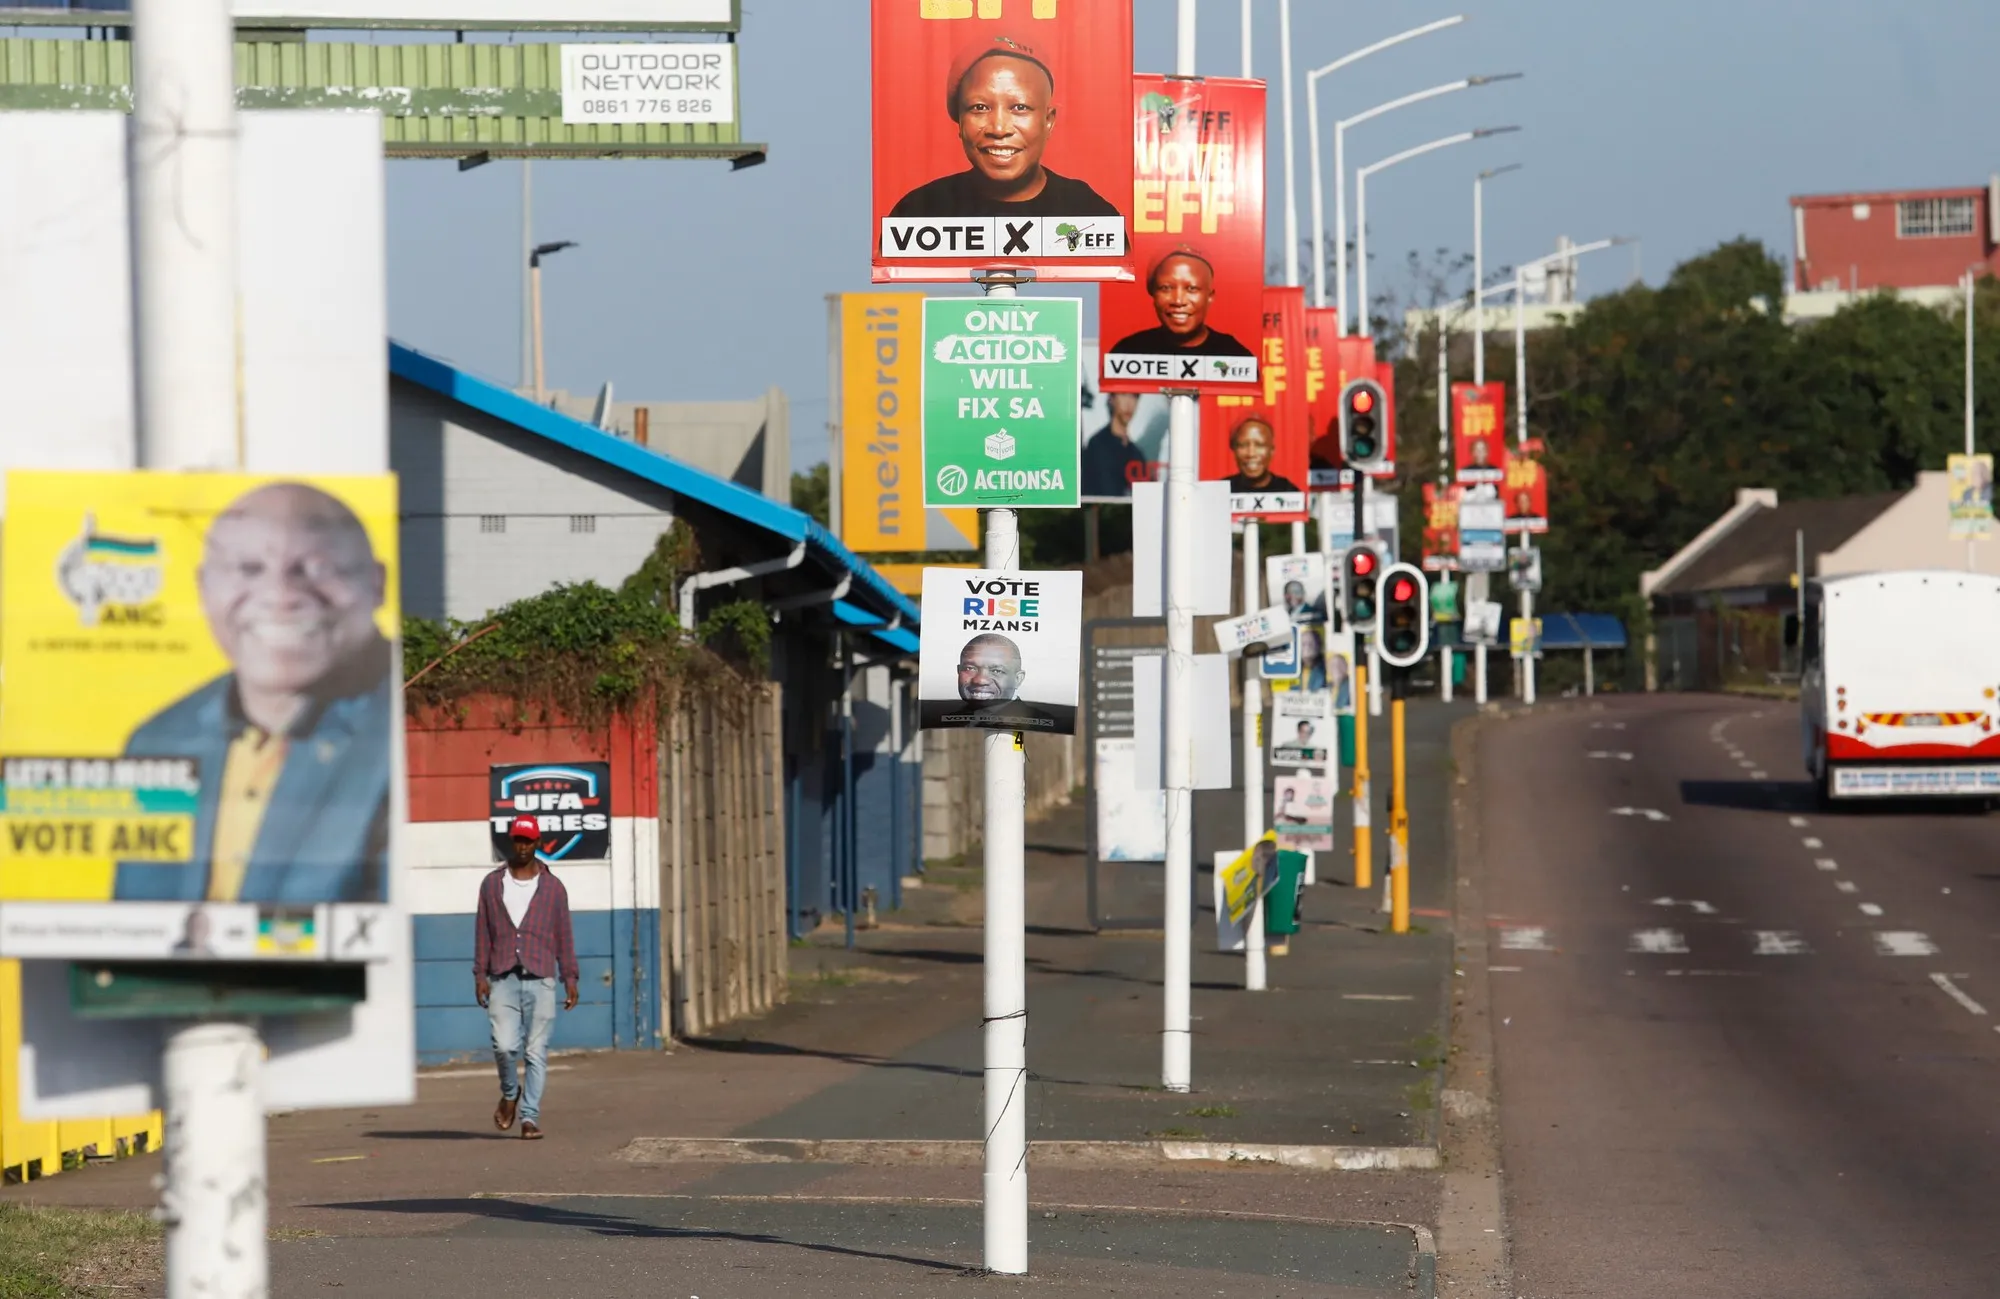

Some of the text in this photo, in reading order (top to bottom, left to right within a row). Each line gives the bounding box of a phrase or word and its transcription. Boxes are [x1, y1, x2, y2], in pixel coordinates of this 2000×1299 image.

[581, 54, 721, 70] OUTDOOR
[582, 75, 721, 90] NETWORK
[583, 99, 713, 114] 0861 776 826
[1187, 110, 1231, 131] EFF
[1134, 180, 1235, 234] EFF
[890, 225, 985, 251] VOTE
[1084, 233, 1115, 247] EFF
[965, 310, 1040, 331] ONLY
[1262, 312, 1282, 329] FF
[949, 339, 1053, 361] ACTION
[1110, 359, 1169, 376] VOTE
[1231, 367, 1251, 377] EFF
[969, 368, 1033, 389] WILL
[958, 397, 1045, 419] FIX SA
[865, 306, 899, 536] metrorail
[974, 469, 1065, 490] ACTIONSA
[965, 580, 1040, 597] VOTE
[963, 597, 1039, 617] RISE
[963, 619, 1039, 632] MZANSI
[513, 793, 584, 811] UFA
[489, 813, 608, 833] TRES
[8, 821, 182, 855] VOTE ANC
